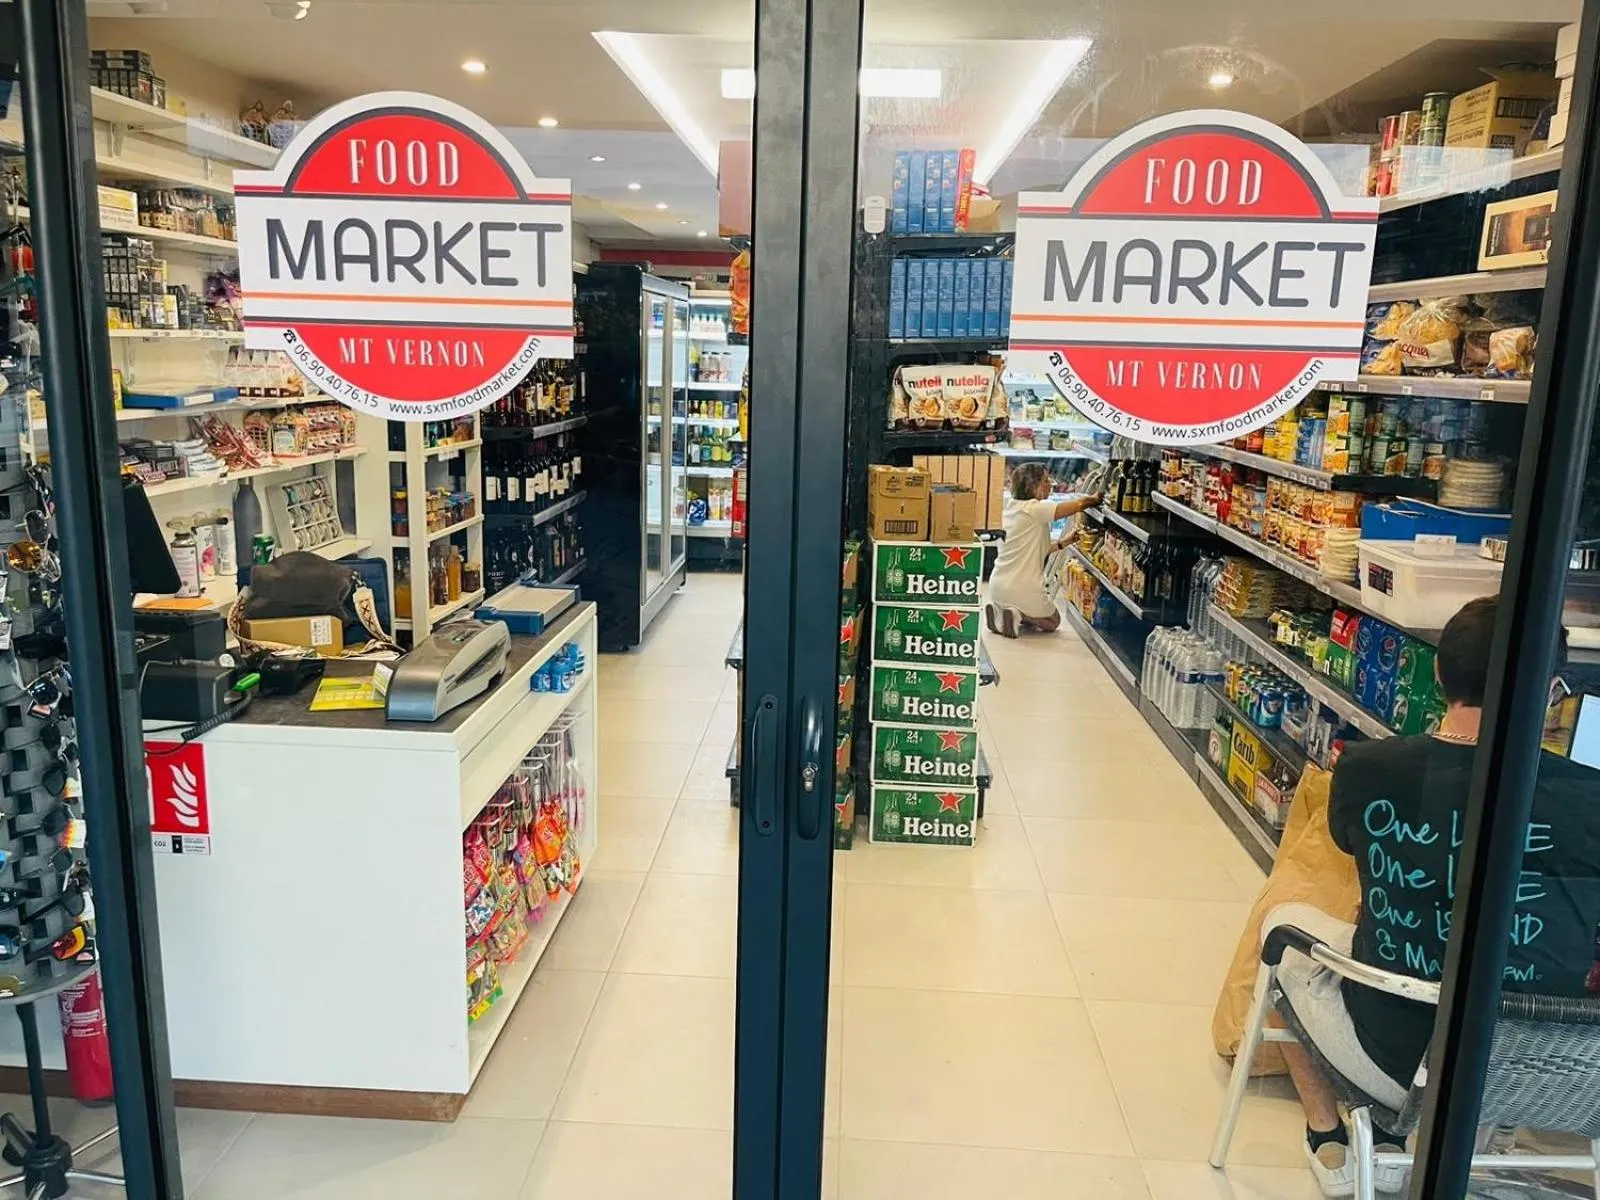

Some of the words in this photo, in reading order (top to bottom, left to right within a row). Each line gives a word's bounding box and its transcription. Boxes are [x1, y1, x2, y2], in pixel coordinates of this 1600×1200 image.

[348, 139, 461, 187] FOOD
[1144, 158, 1263, 206] FOOD
[266, 218, 564, 288] MARKET
[1043, 238, 1366, 309] MARKET
[339, 337, 373, 365] MT
[386, 338, 485, 367] VERNON
[294, 344, 379, 408] 06.90.40.76.15
[389, 337, 541, 414] www.sxmfoodmarket.com
[908, 376, 943, 389] nutell
[946, 375, 989, 387] nutella
[1105, 360, 1144, 388] MT
[1157, 360, 1264, 390] VERNON
[1057, 367, 1141, 432] 06.90.40.76.15
[1151, 359, 1324, 439] www.sxmfoodmarket.com
[909, 547, 921, 556] 24
[907, 609, 919, 618] 24
[905, 671, 917, 679] 24
[906, 730, 918, 739] 24
[905, 792, 917, 800] 24
[1364, 800, 1439, 844] One
[1368, 842, 1436, 888] One
[1368, 887, 1422, 928] One
